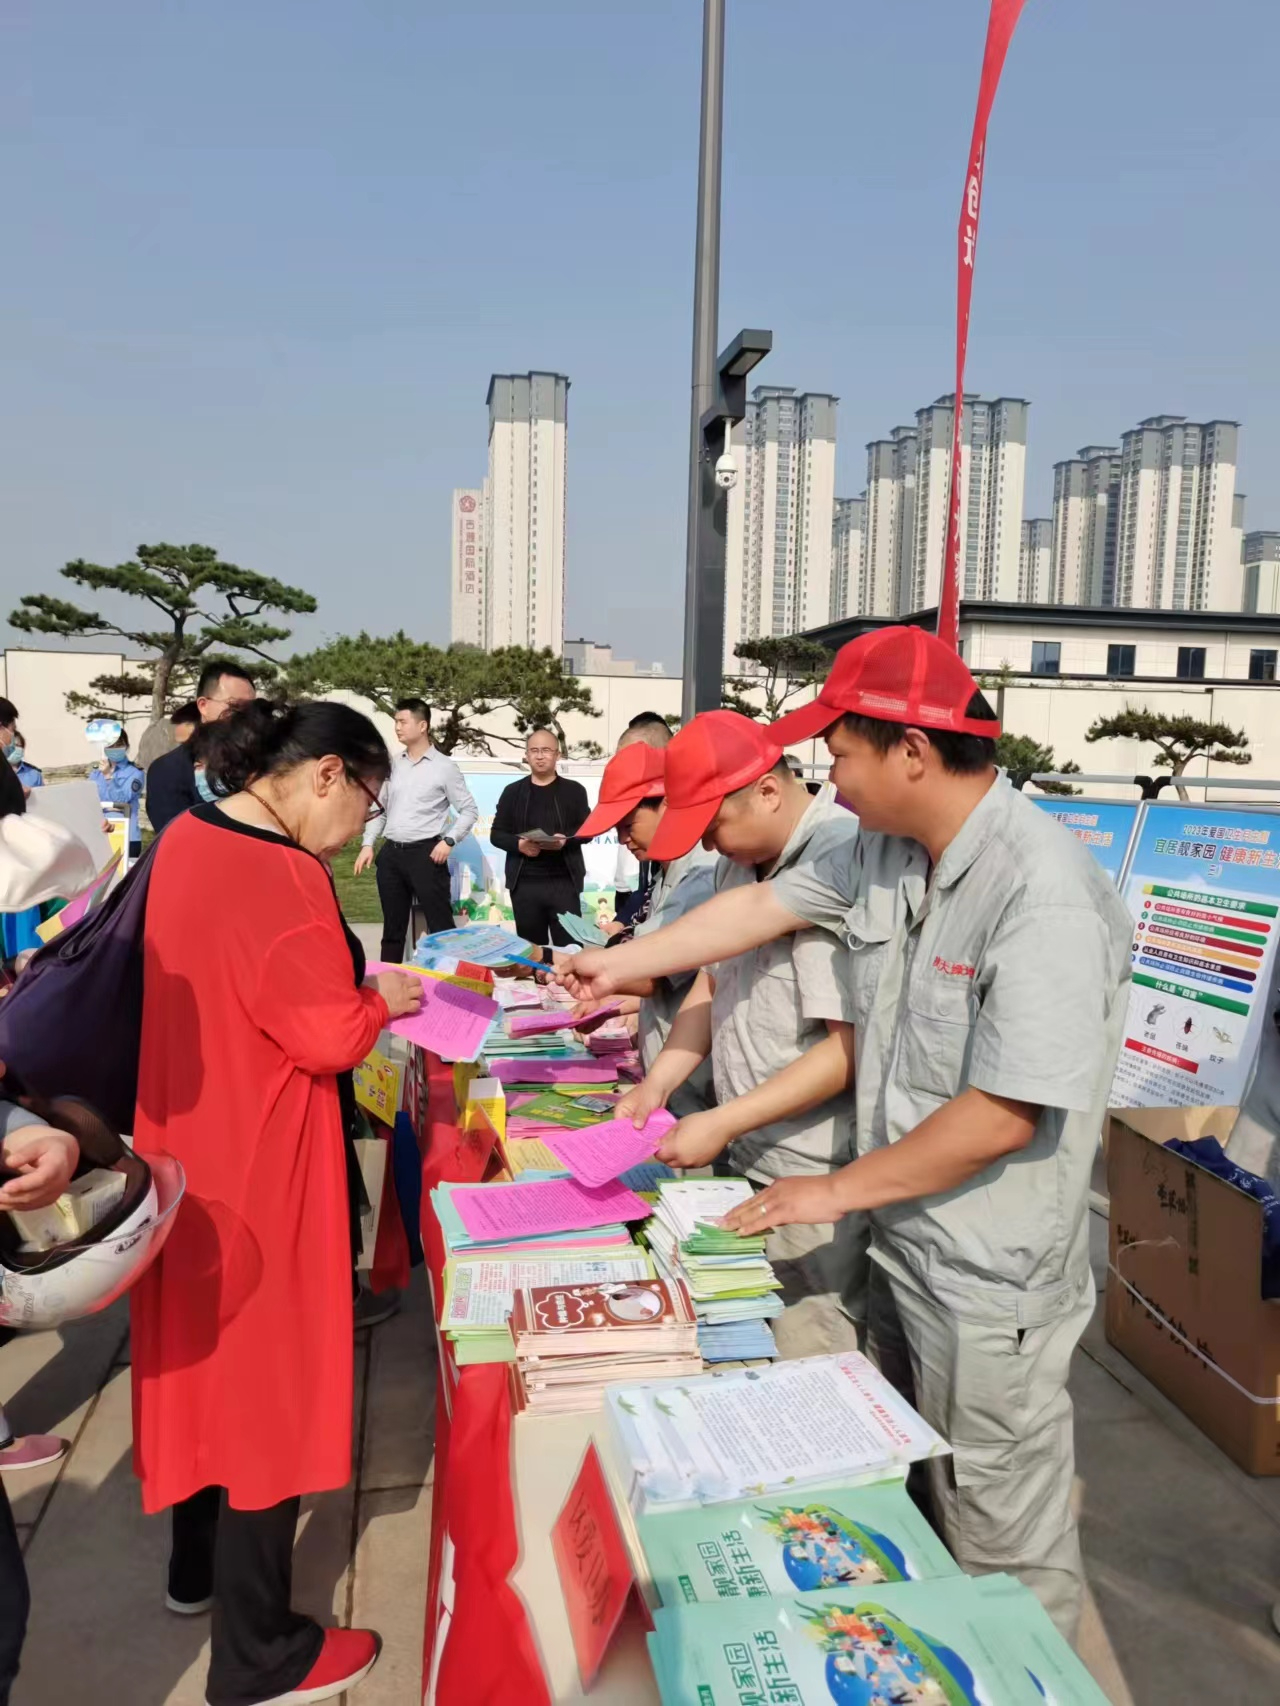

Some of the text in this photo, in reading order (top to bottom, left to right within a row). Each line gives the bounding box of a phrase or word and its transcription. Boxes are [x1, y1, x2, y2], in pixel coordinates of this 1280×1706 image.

[1069, 829, 1113, 847] 康新生活
[1154, 838, 1280, 869] 宜居靓家园 健康新生
[1166, 889, 1246, 911] 公共场所的基本卫生要求
